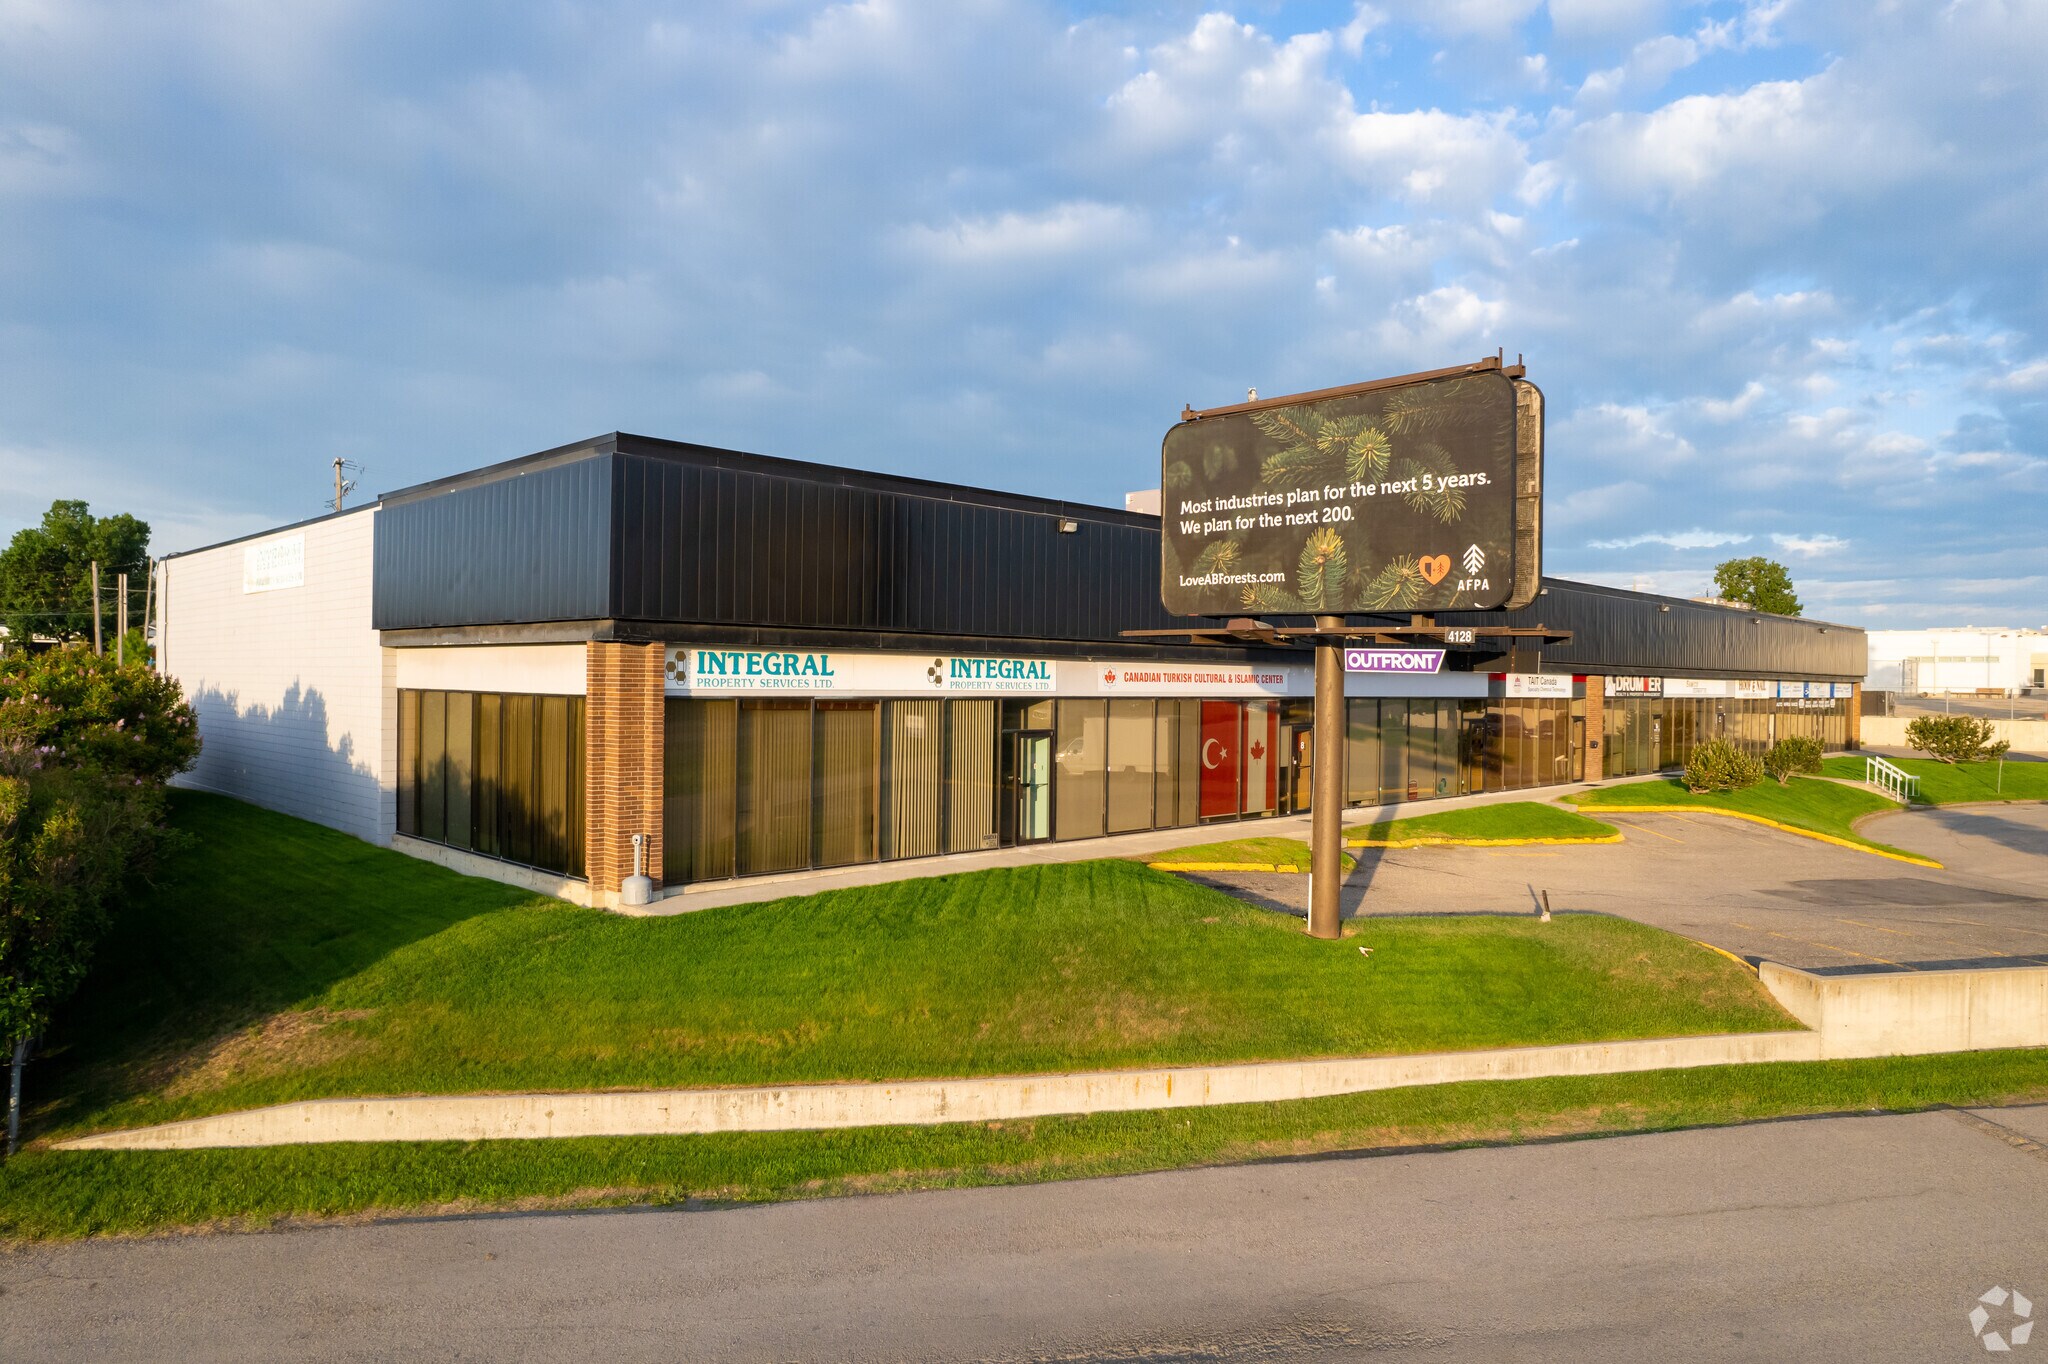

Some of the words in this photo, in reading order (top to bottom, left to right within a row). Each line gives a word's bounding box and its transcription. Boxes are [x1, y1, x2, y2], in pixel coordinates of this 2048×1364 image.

[1180, 499, 1213, 515] Most
[1215, 491, 1284, 511] industries
[1287, 488, 1320, 508] plan
[1323, 484, 1347, 501] for
[1350, 481, 1377, 498] the
[1380, 476, 1418, 495] next
[1422, 473, 1433, 491] 5
[1437, 472, 1492, 493] years.
[1180, 520, 1201, 535] We
[1204, 518, 1233, 536] plan
[1235, 515, 1256, 530] for
[1259, 512, 1283, 528] the
[1285, 509, 1319, 526] next
[1322, 505, 1355, 523] 200.
[1179, 571, 1286, 587] LoveABForests.com
[1457, 578, 1490, 592] AFPA
[1448, 630, 1472, 643] 4128
[697, 651, 835, 677] INTEGRAL
[1348, 652, 1437, 670] OUTFRONT
[950, 658, 1051, 680] INTEGRAL
[697, 677, 755, 688] PROPERTY
[760, 678, 810, 689] SERVICES
[814, 679, 835, 689] LTD.
[1124, 671, 1161, 683] CANADIAN
[1163, 672, 1193, 683] TURKISH
[1194, 673, 1226, 684] CULTURAL
[1228, 674, 1233, 684] &
[1234, 674, 1260, 684] ISLAMIC
[1261, 674, 1284, 685] CENTER
[1528, 676, 1539, 686] TAIT
[1540, 676, 1558, 686] Canada
[950, 680, 993, 690] PROPERTY
[995, 681, 1033, 690] SERVICES
[1035, 682, 1051, 691] LTD.
[1300, 741, 1305, 750] 8
